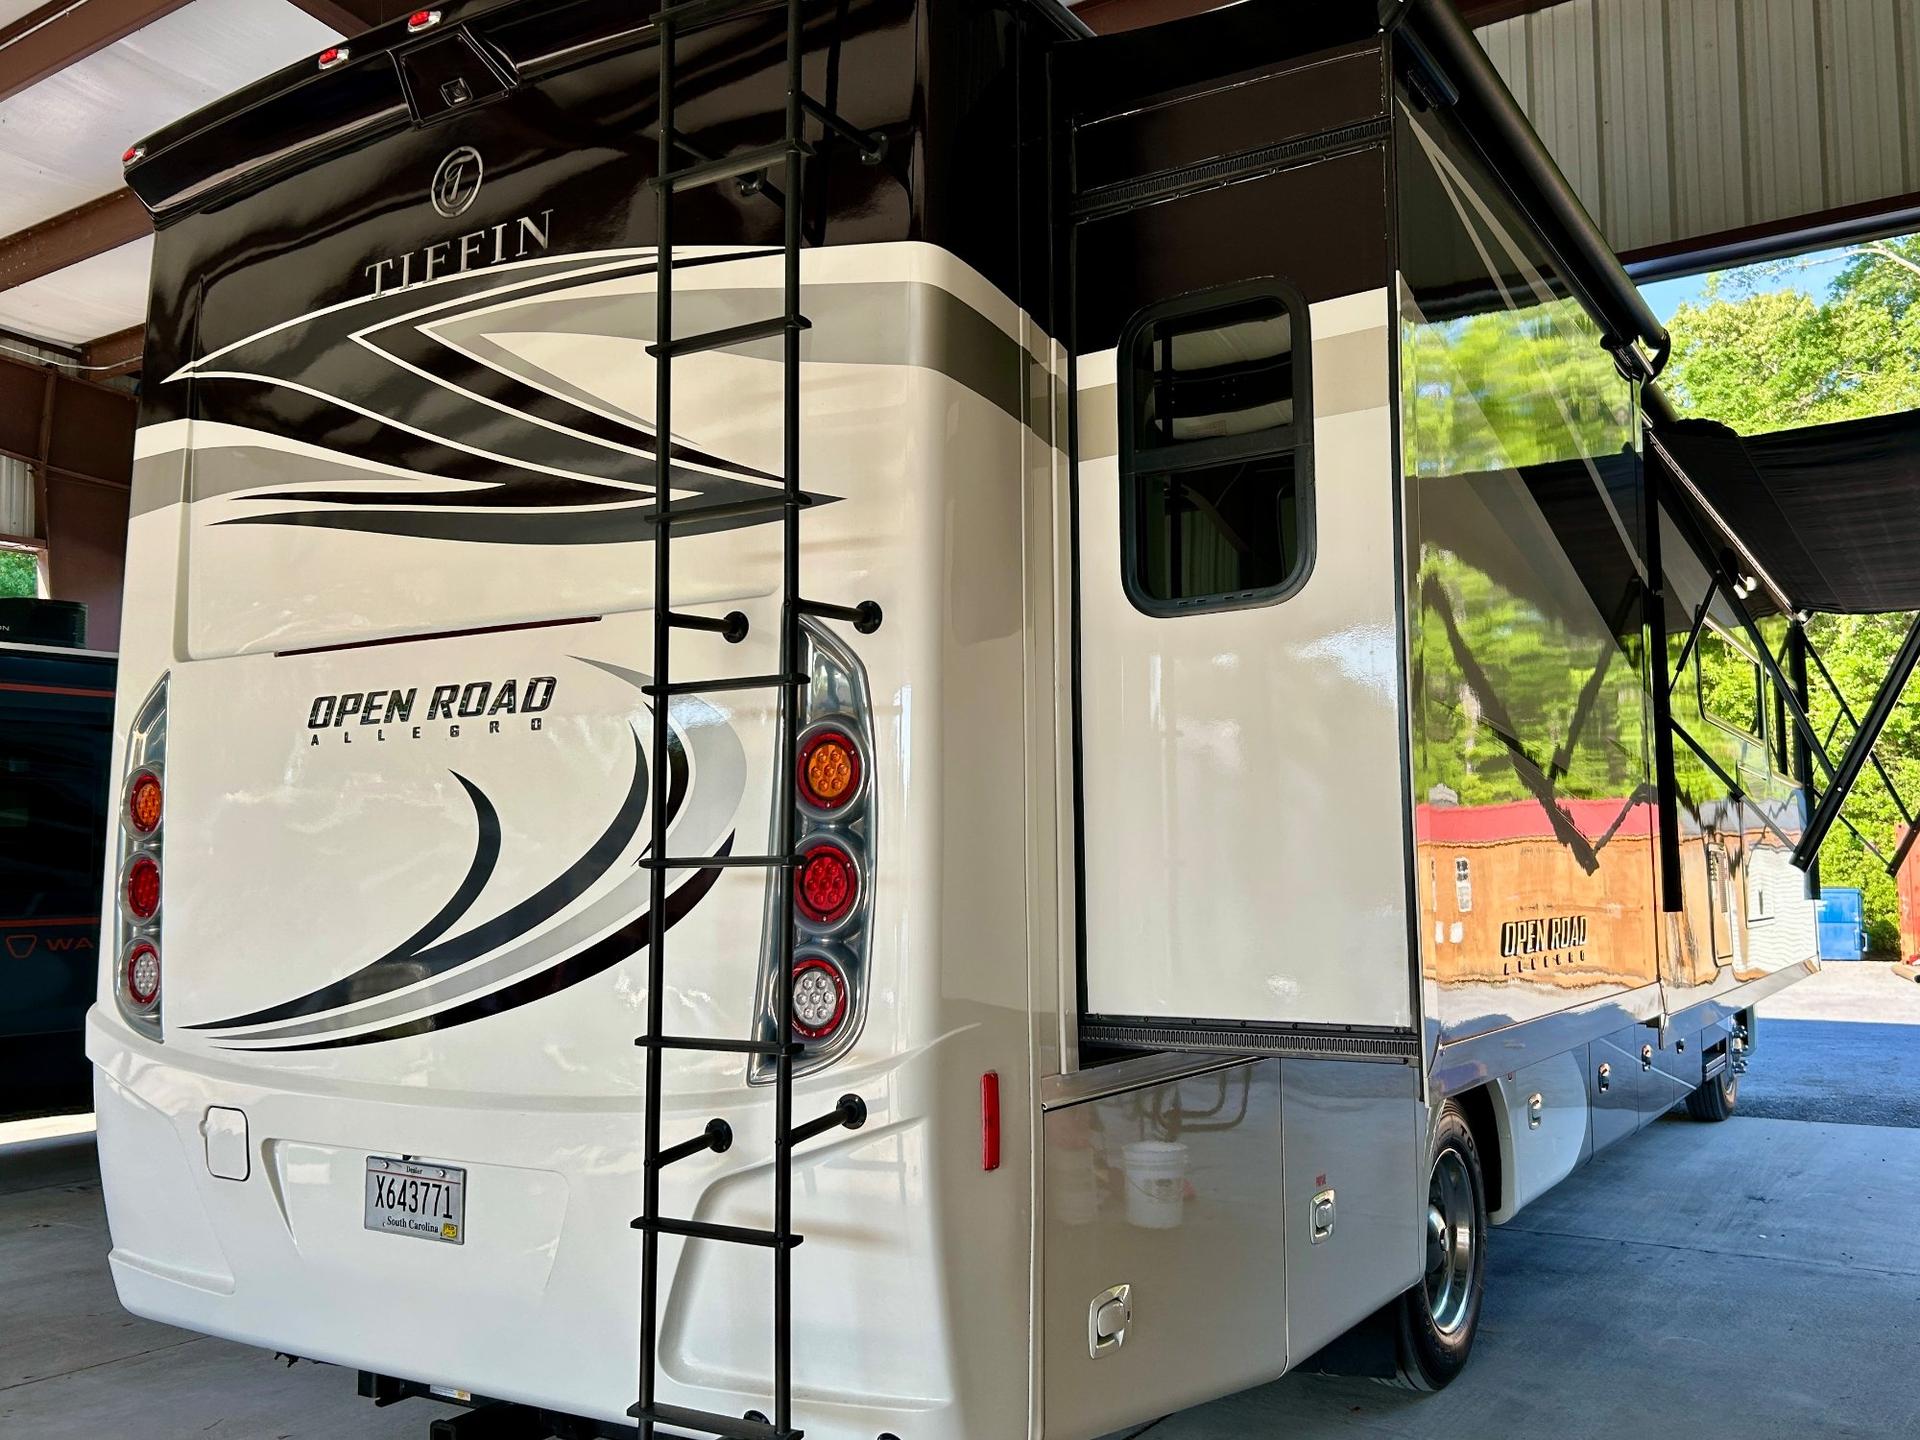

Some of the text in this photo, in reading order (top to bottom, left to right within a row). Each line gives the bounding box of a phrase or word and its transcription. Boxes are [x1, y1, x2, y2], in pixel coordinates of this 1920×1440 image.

[365, 209, 554, 299] TIFFIN
[307, 676, 558, 729] OPEN ROAD
[310, 717, 542, 746] ALLEGRO
[1501, 914, 1588, 958] OPEN ROAD
[375, 1174, 453, 1219] X643771
[387, 1216, 407, 1229] South
[408, 1219, 439, 1233] Carolina
